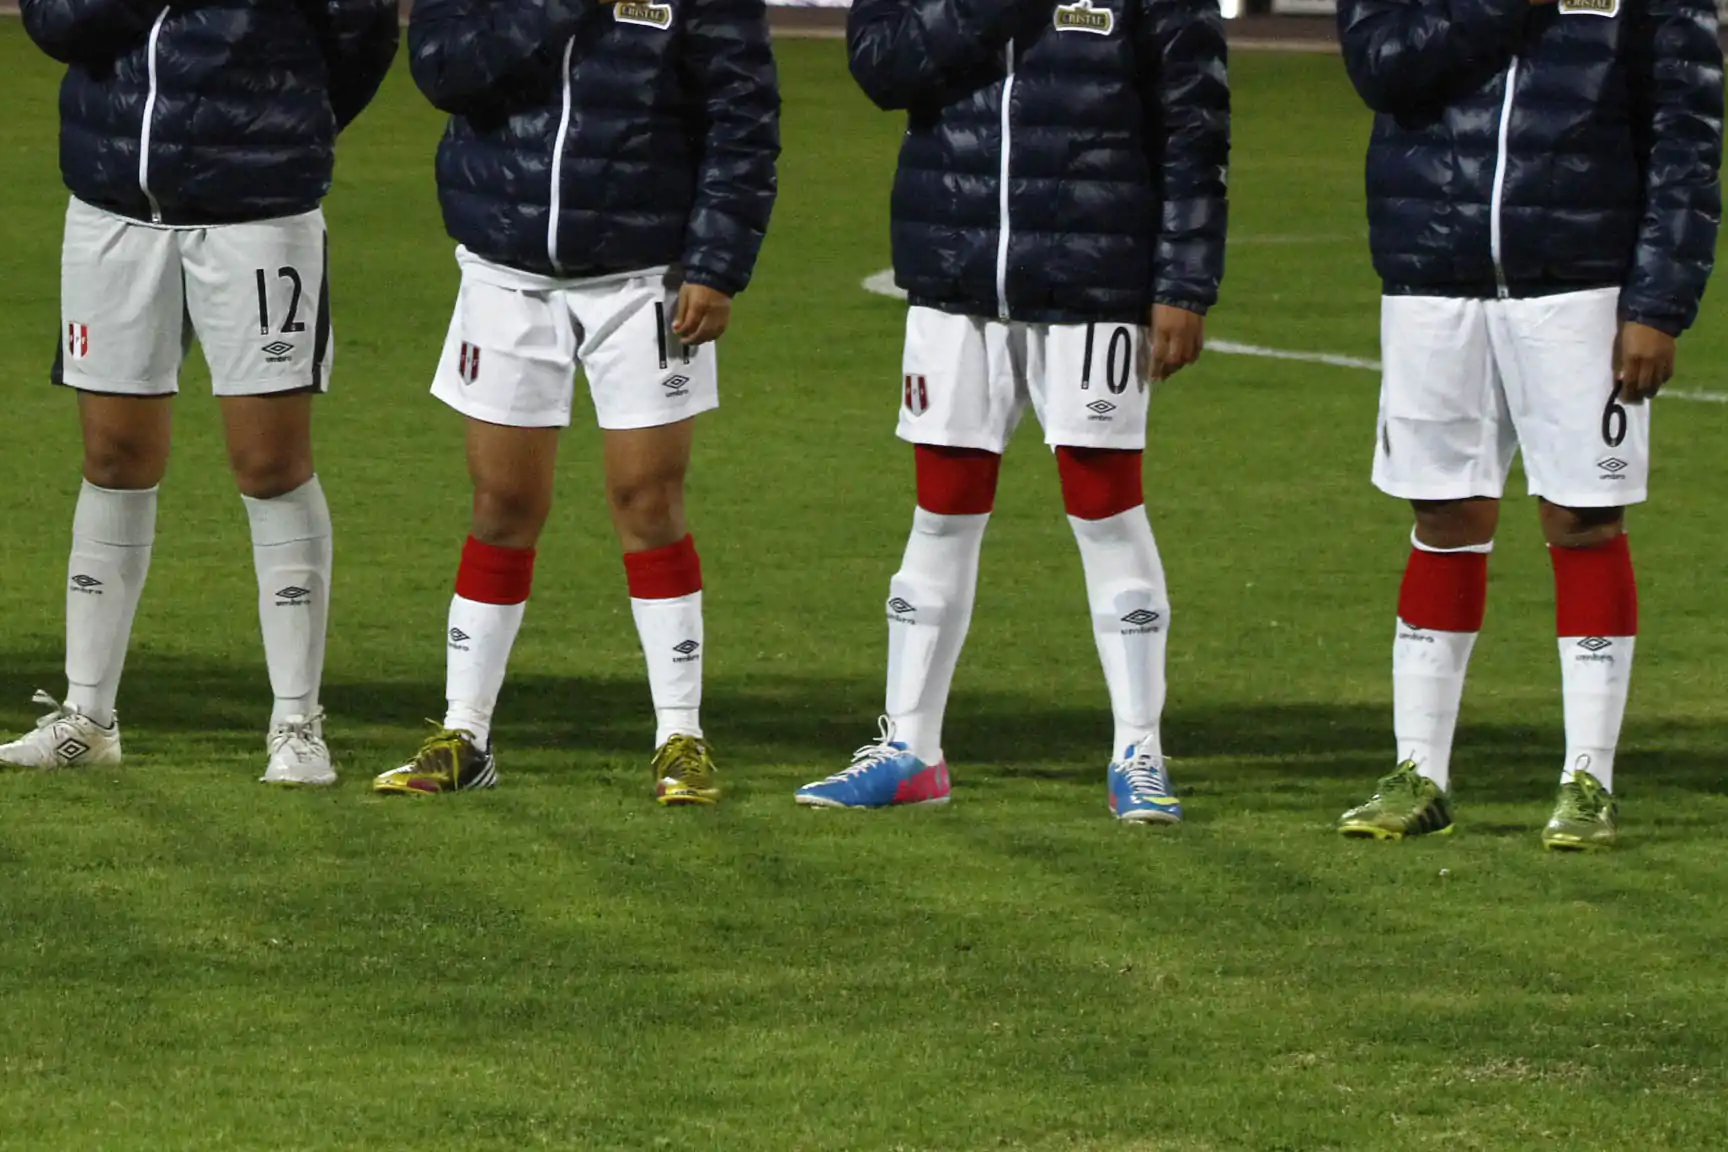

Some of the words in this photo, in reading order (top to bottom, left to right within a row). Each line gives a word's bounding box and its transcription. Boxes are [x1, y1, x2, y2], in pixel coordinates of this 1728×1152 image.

[1061, 12, 1105, 26] CRISTAL
[255, 266, 306, 336] 12
[1080, 323, 1132, 395] 10
